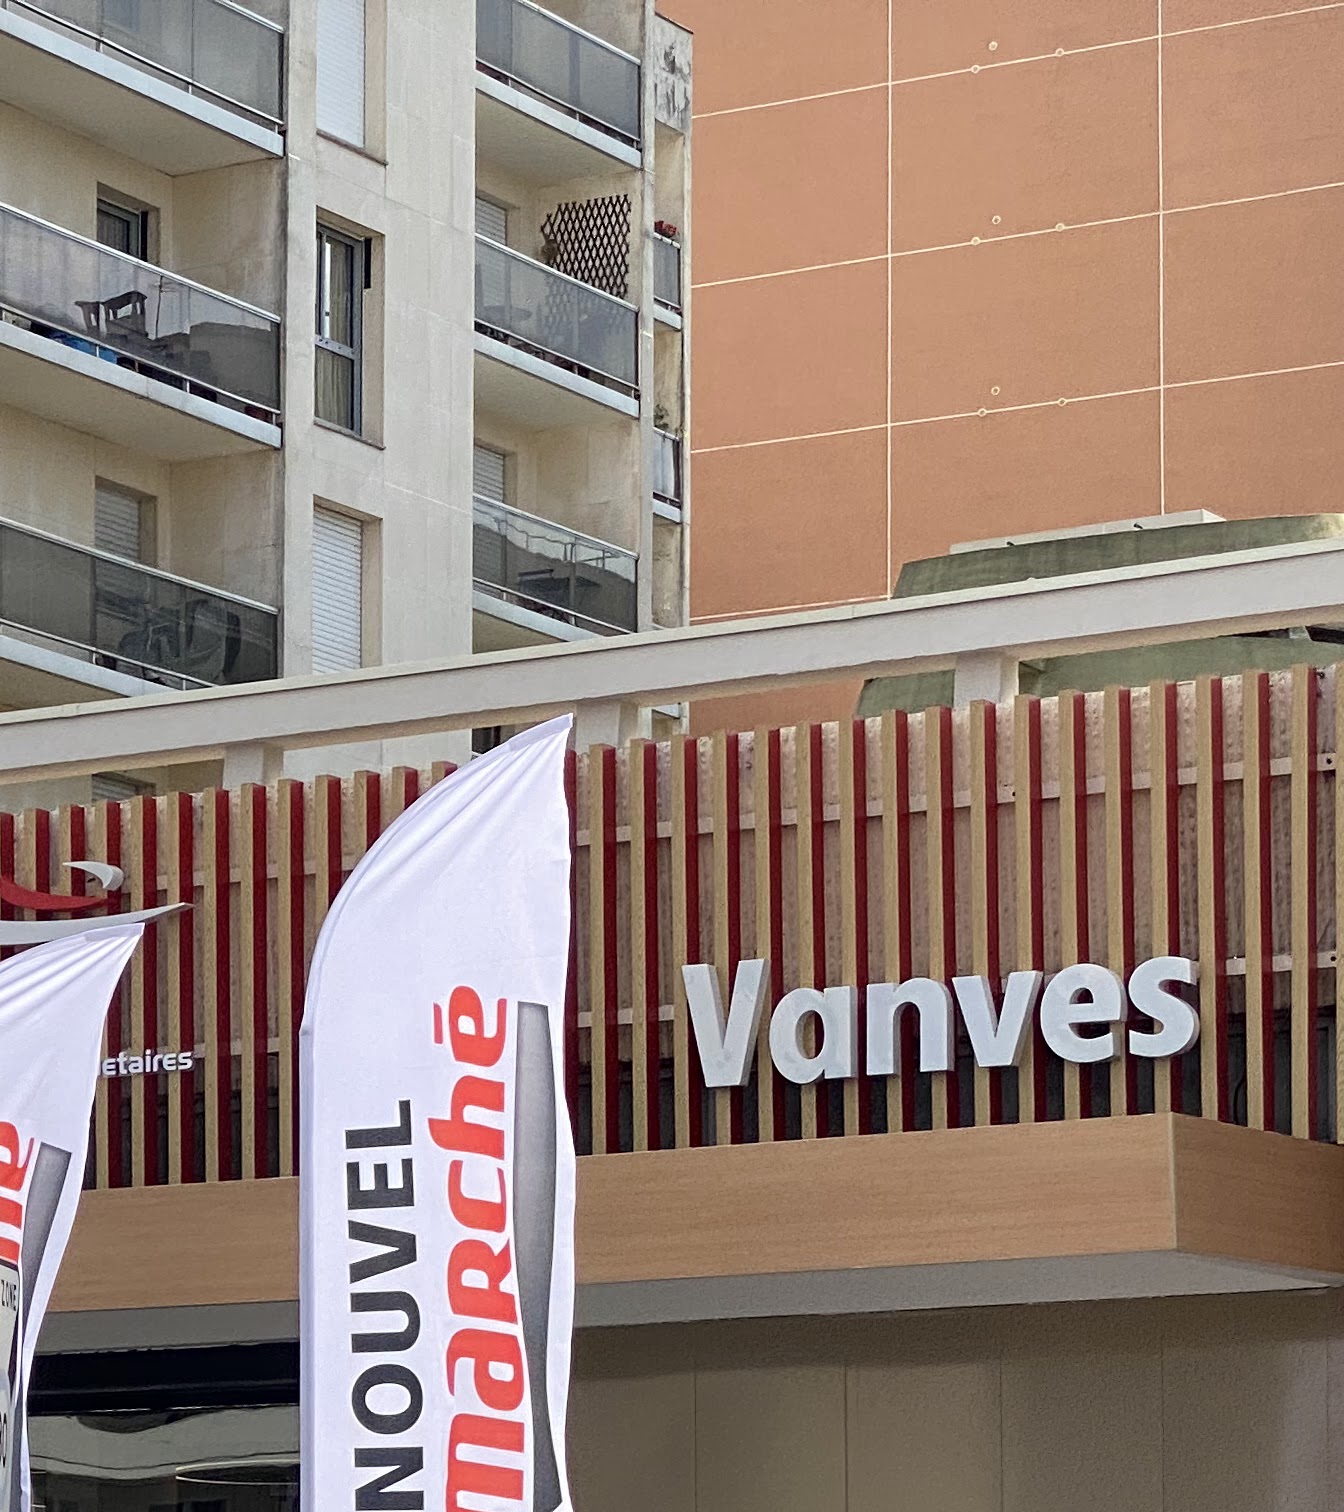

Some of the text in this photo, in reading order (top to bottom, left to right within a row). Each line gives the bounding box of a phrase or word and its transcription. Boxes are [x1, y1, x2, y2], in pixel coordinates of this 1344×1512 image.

[98, 1049, 193, 1077] etaires
[681, 956, 1200, 1088] Vanves
[1, 1279, 17, 1312] ZONE
[345, 1100, 425, 1512] NOUVEL
